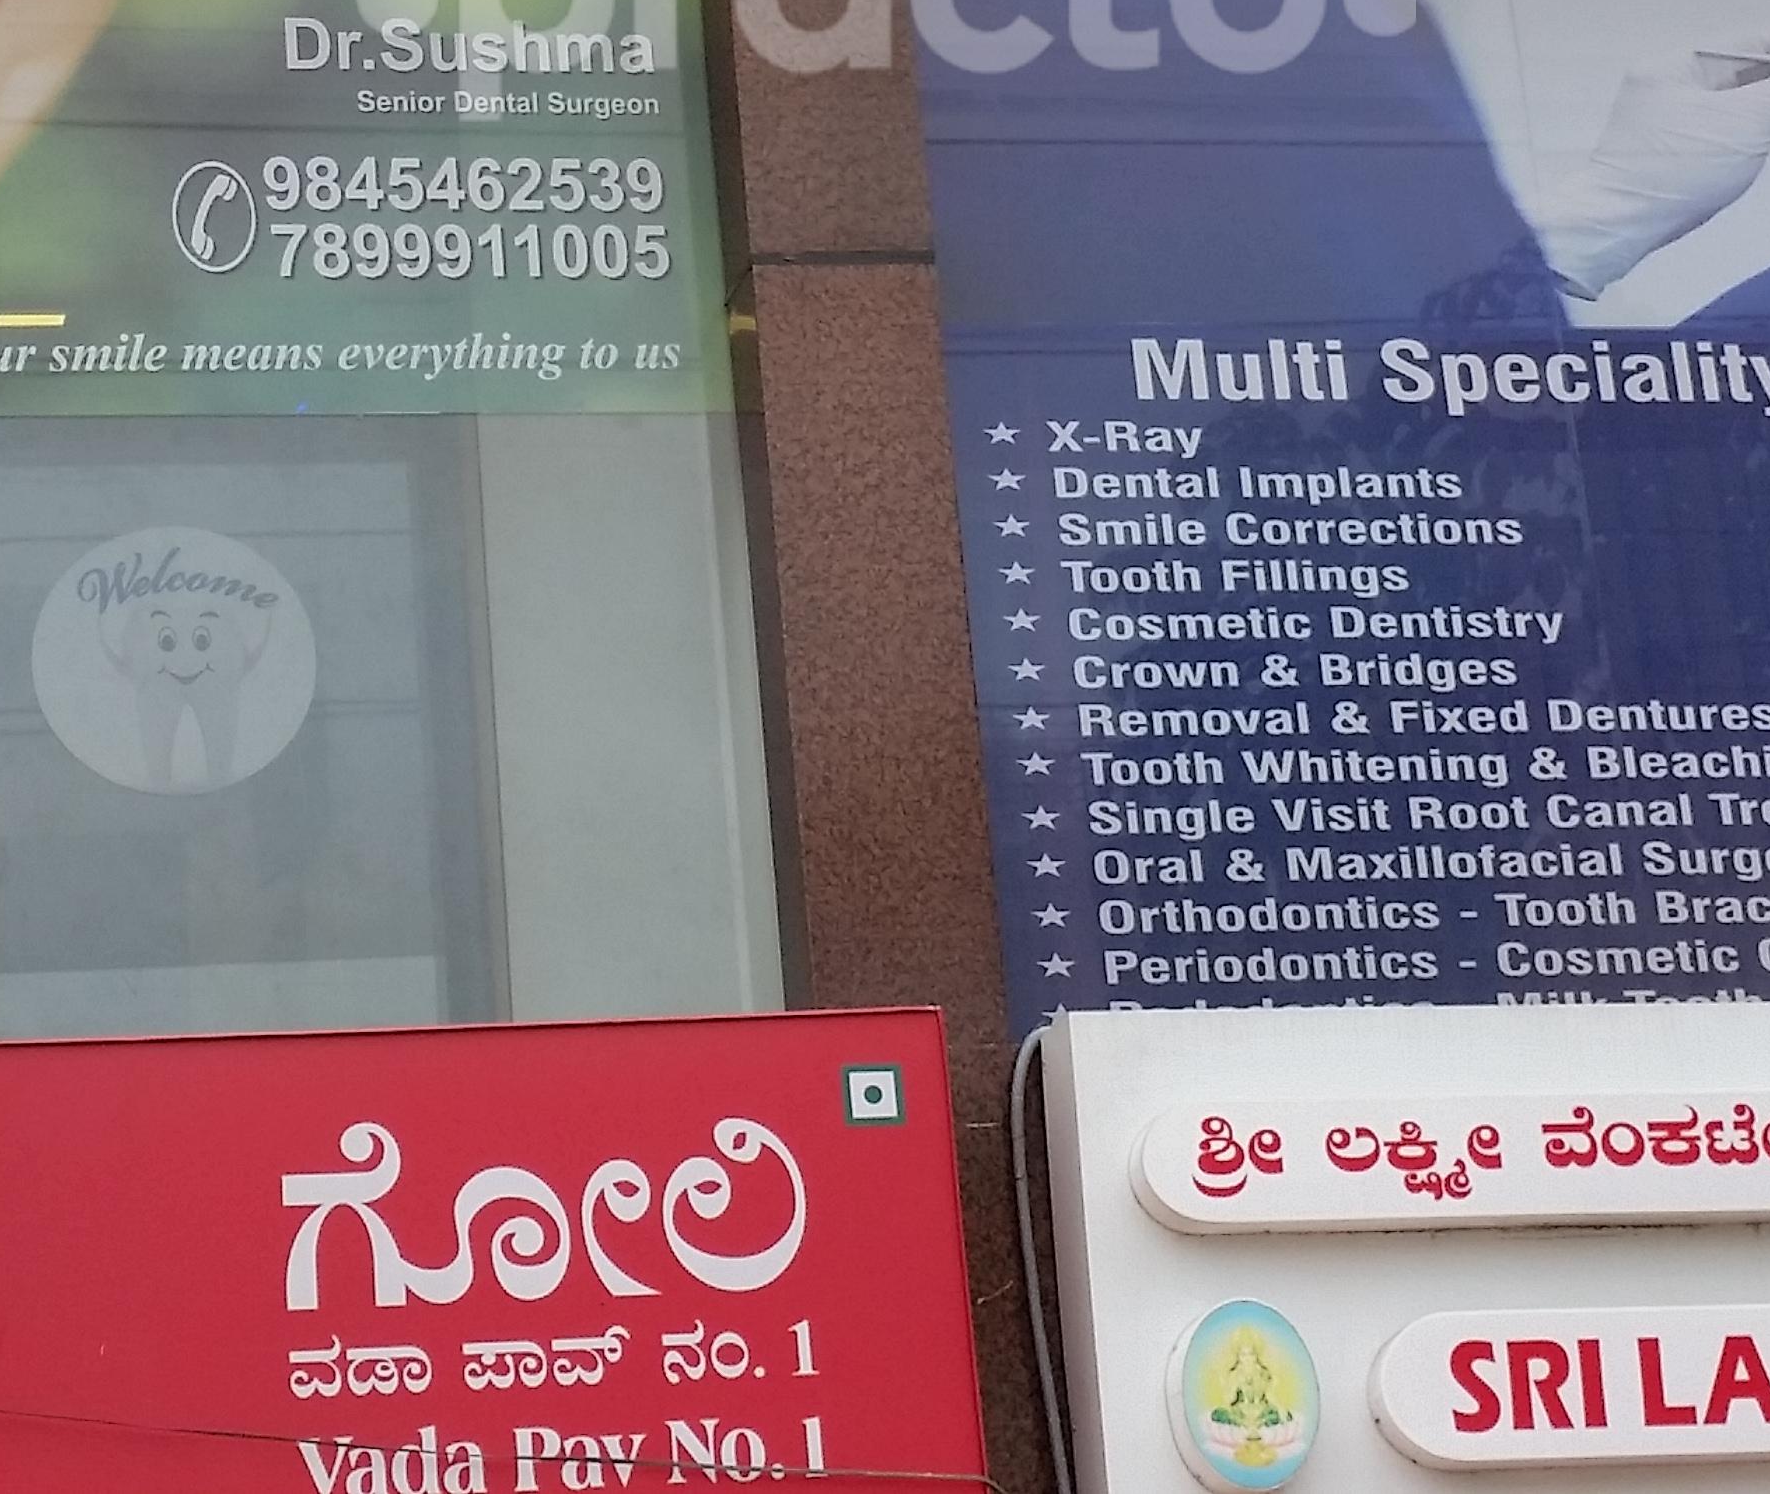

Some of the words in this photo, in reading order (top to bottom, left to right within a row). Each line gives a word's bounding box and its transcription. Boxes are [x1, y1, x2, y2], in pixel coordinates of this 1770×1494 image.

[283, 16, 656, 75] Dr.Sushma
[356, 89, 446, 115] Senior
[453, 91, 540, 115] Dental
[547, 91, 661, 120] Surgeon
[262, 156, 666, 213] 9845462539
[269, 223, 672, 281] 7899911005
[49, 333, 167, 375] smile
[181, 340, 323, 373] means
[337, 333, 563, 380] everything
[579, 336, 620, 372] to
[635, 343, 681, 372] us
[1130, 337, 1349, 401] Multi
[1047, 420, 1202, 459] X-Ray
[1052, 466, 1219, 500] Dental
[1240, 466, 1463, 506] Implants
[1058, 513, 1207, 548] Smile
[1225, 513, 1524, 547] Corrections
[76, 546, 280, 611] Welcome
[1061, 559, 1202, 594] Tooth
[1221, 559, 1410, 599] Fillings
[1068, 606, 1312, 642] Cosmetic
[1331, 605, 1564, 645] Dentistry
[1073, 655, 1240, 690] Crown
[1260, 654, 1299, 686] &
[1320, 652, 1518, 693] Bridges
[1079, 702, 1310, 738] Removal
[1330, 702, 1369, 735] &
[1390, 700, 1529, 734] Fixed
[1081, 749, 1224, 787] Tooth
[1241, 747, 1509, 789] Whitening
[1528, 747, 1567, 781] &
[1088, 798, 1255, 843] Single
[1270, 797, 1391, 833] Visit
[1404, 795, 1530, 831] Root
[1546, 793, 1694, 829] Canal
[1093, 848, 1205, 886] Oral
[1226, 848, 1266, 882] &
[1285, 842, 1623, 882] Maxillofacial
[1097, 896, 1441, 936] Orthodontics
[1493, 890, 1636, 928] Tooth
[1102, 945, 1439, 985] Periodontics
[1495, 938, 1740, 977] Cosmetic
[1191, 1114, 1285, 1199] ಶ್ರೀ
[281, 1117, 807, 1311] ಗೋಲಿ
[288, 1335, 433, 1399] ವಡಾ
[789, 1320, 820, 1376] 1
[1449, 1336, 1608, 1433] SRI
[298, 1425, 487, 1494] Vada
[513, 1426, 648, 1492] Pav
[667, 1416, 826, 1486] No.1
